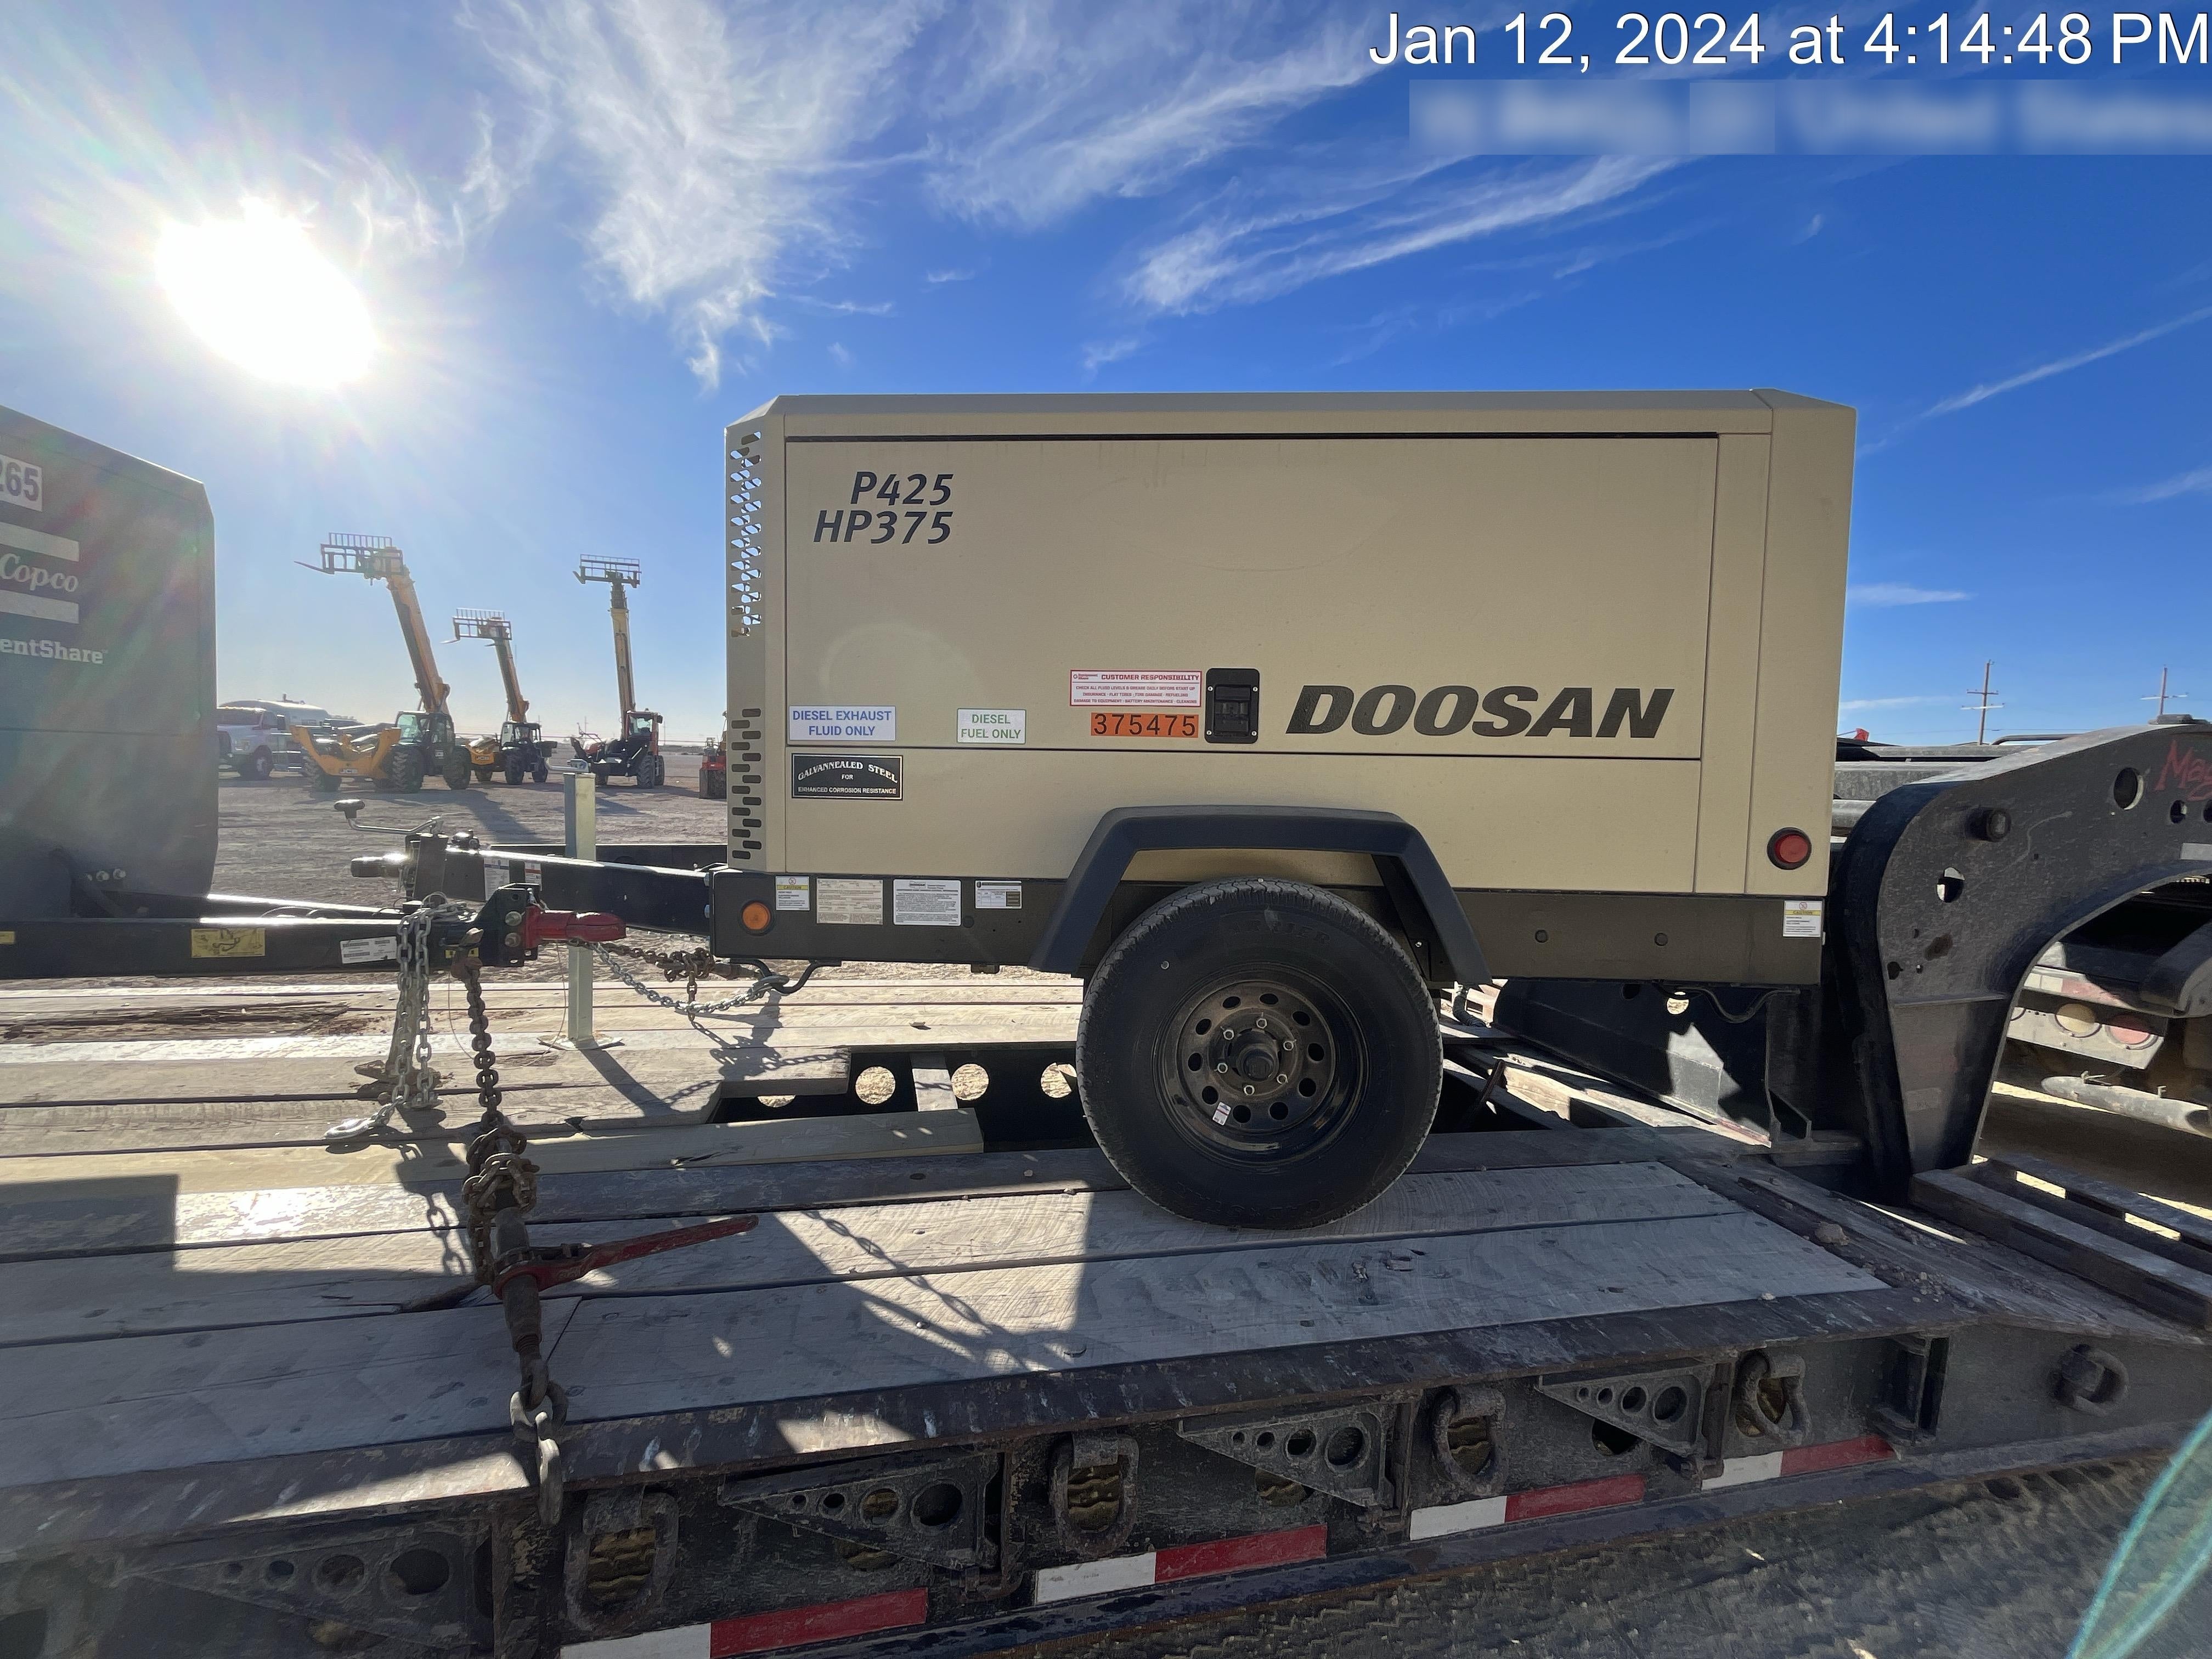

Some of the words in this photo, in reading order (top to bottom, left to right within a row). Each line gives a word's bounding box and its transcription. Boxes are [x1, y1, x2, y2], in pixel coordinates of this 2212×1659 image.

[0, 460, 40, 502] 65
[850, 471, 954, 506] P425
[813, 510, 953, 544] HP375
[0, 553, 79, 592] Copco
[792, 710, 833, 721] DIESEL
[836, 710, 892, 721] EXHAUST
[972, 714, 1011, 724] DIESEL
[1285, 684, 1675, 738] DOOSAN
[808, 725, 842, 736] FLUID
[845, 725, 876, 736] ONLY
[961, 728, 989, 738] FUEL
[992, 729, 1021, 739] ONLY
[1093, 714, 1195, 736] 375475
[798, 761, 864, 781] GALVANNEALED
[868, 764, 898, 783] STEEL
